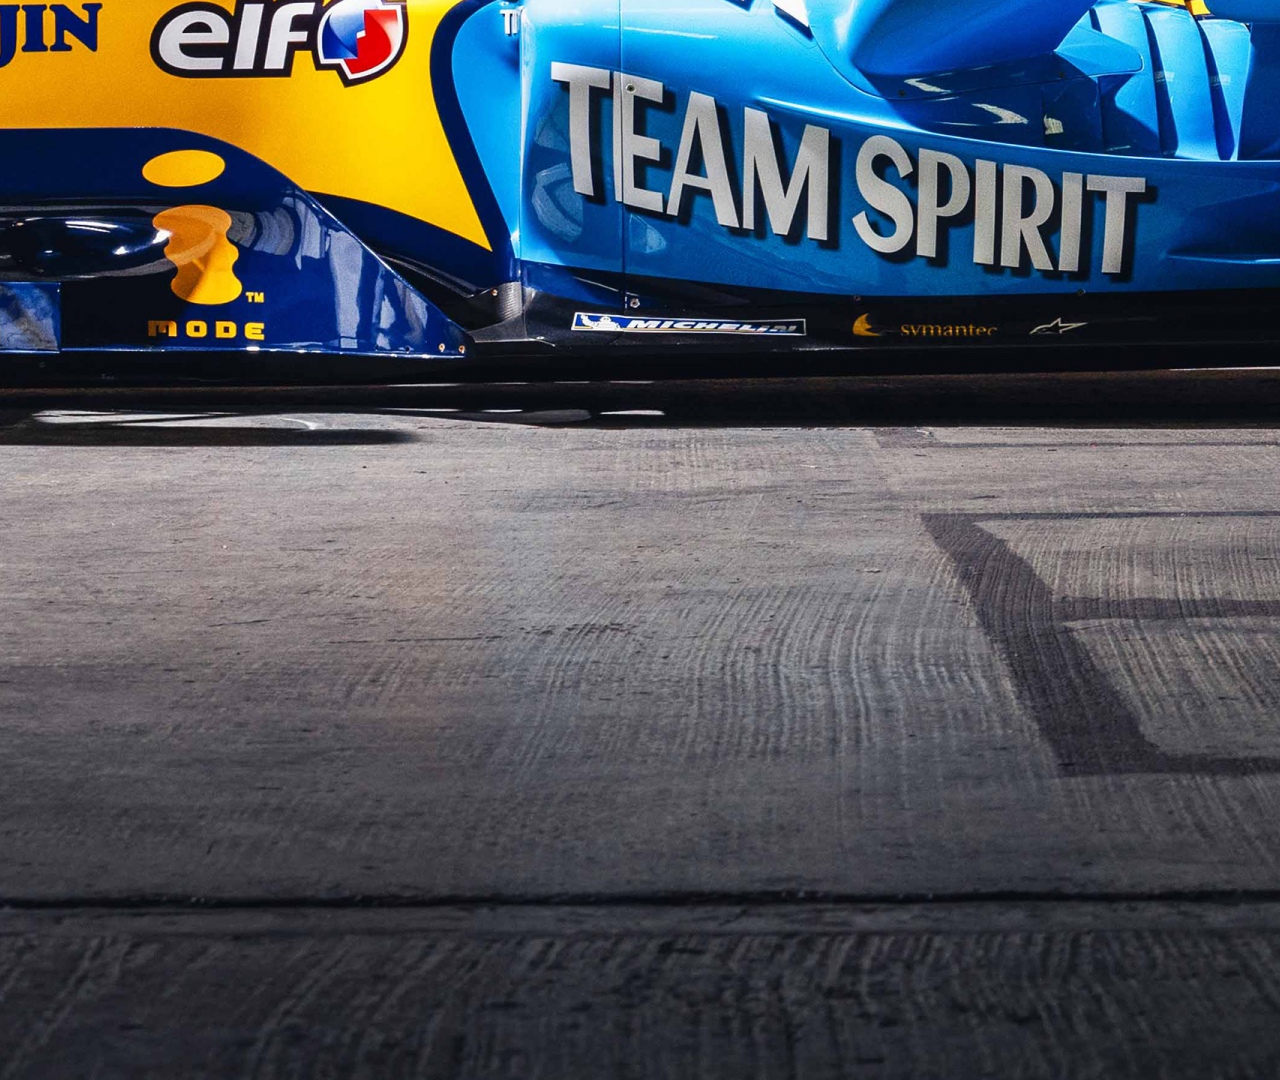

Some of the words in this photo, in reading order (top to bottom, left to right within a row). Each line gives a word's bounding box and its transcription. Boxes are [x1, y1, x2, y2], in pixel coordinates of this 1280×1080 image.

[157, 1, 316, 71] elf
[550, 61, 830, 242] TEAM
[852, 134, 1147, 274] SPIRIT
[147, 320, 266, 341] MODE
[626, 319, 798, 333] MICHELIN
[900, 323, 998, 337] symantec
